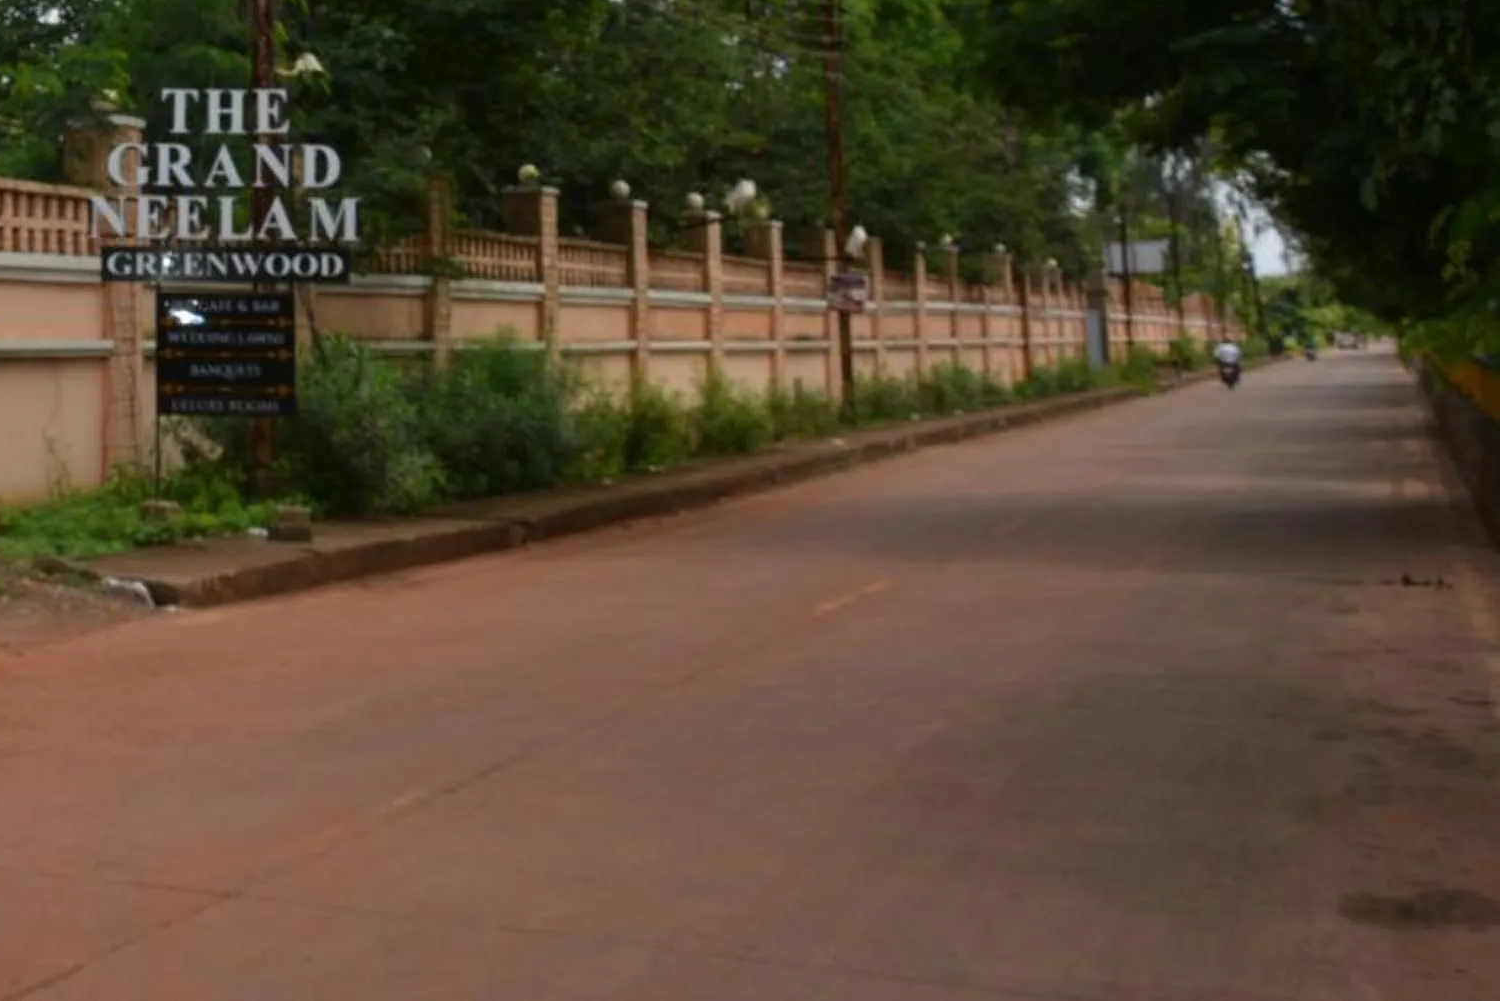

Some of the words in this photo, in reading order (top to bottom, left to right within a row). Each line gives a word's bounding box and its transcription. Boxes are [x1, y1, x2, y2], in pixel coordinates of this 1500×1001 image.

[161, 87, 291, 134] THE
[107, 142, 341, 189] GRAND
[89, 195, 362, 242] NEELAM
[106, 252, 345, 278] GREENWOOD
